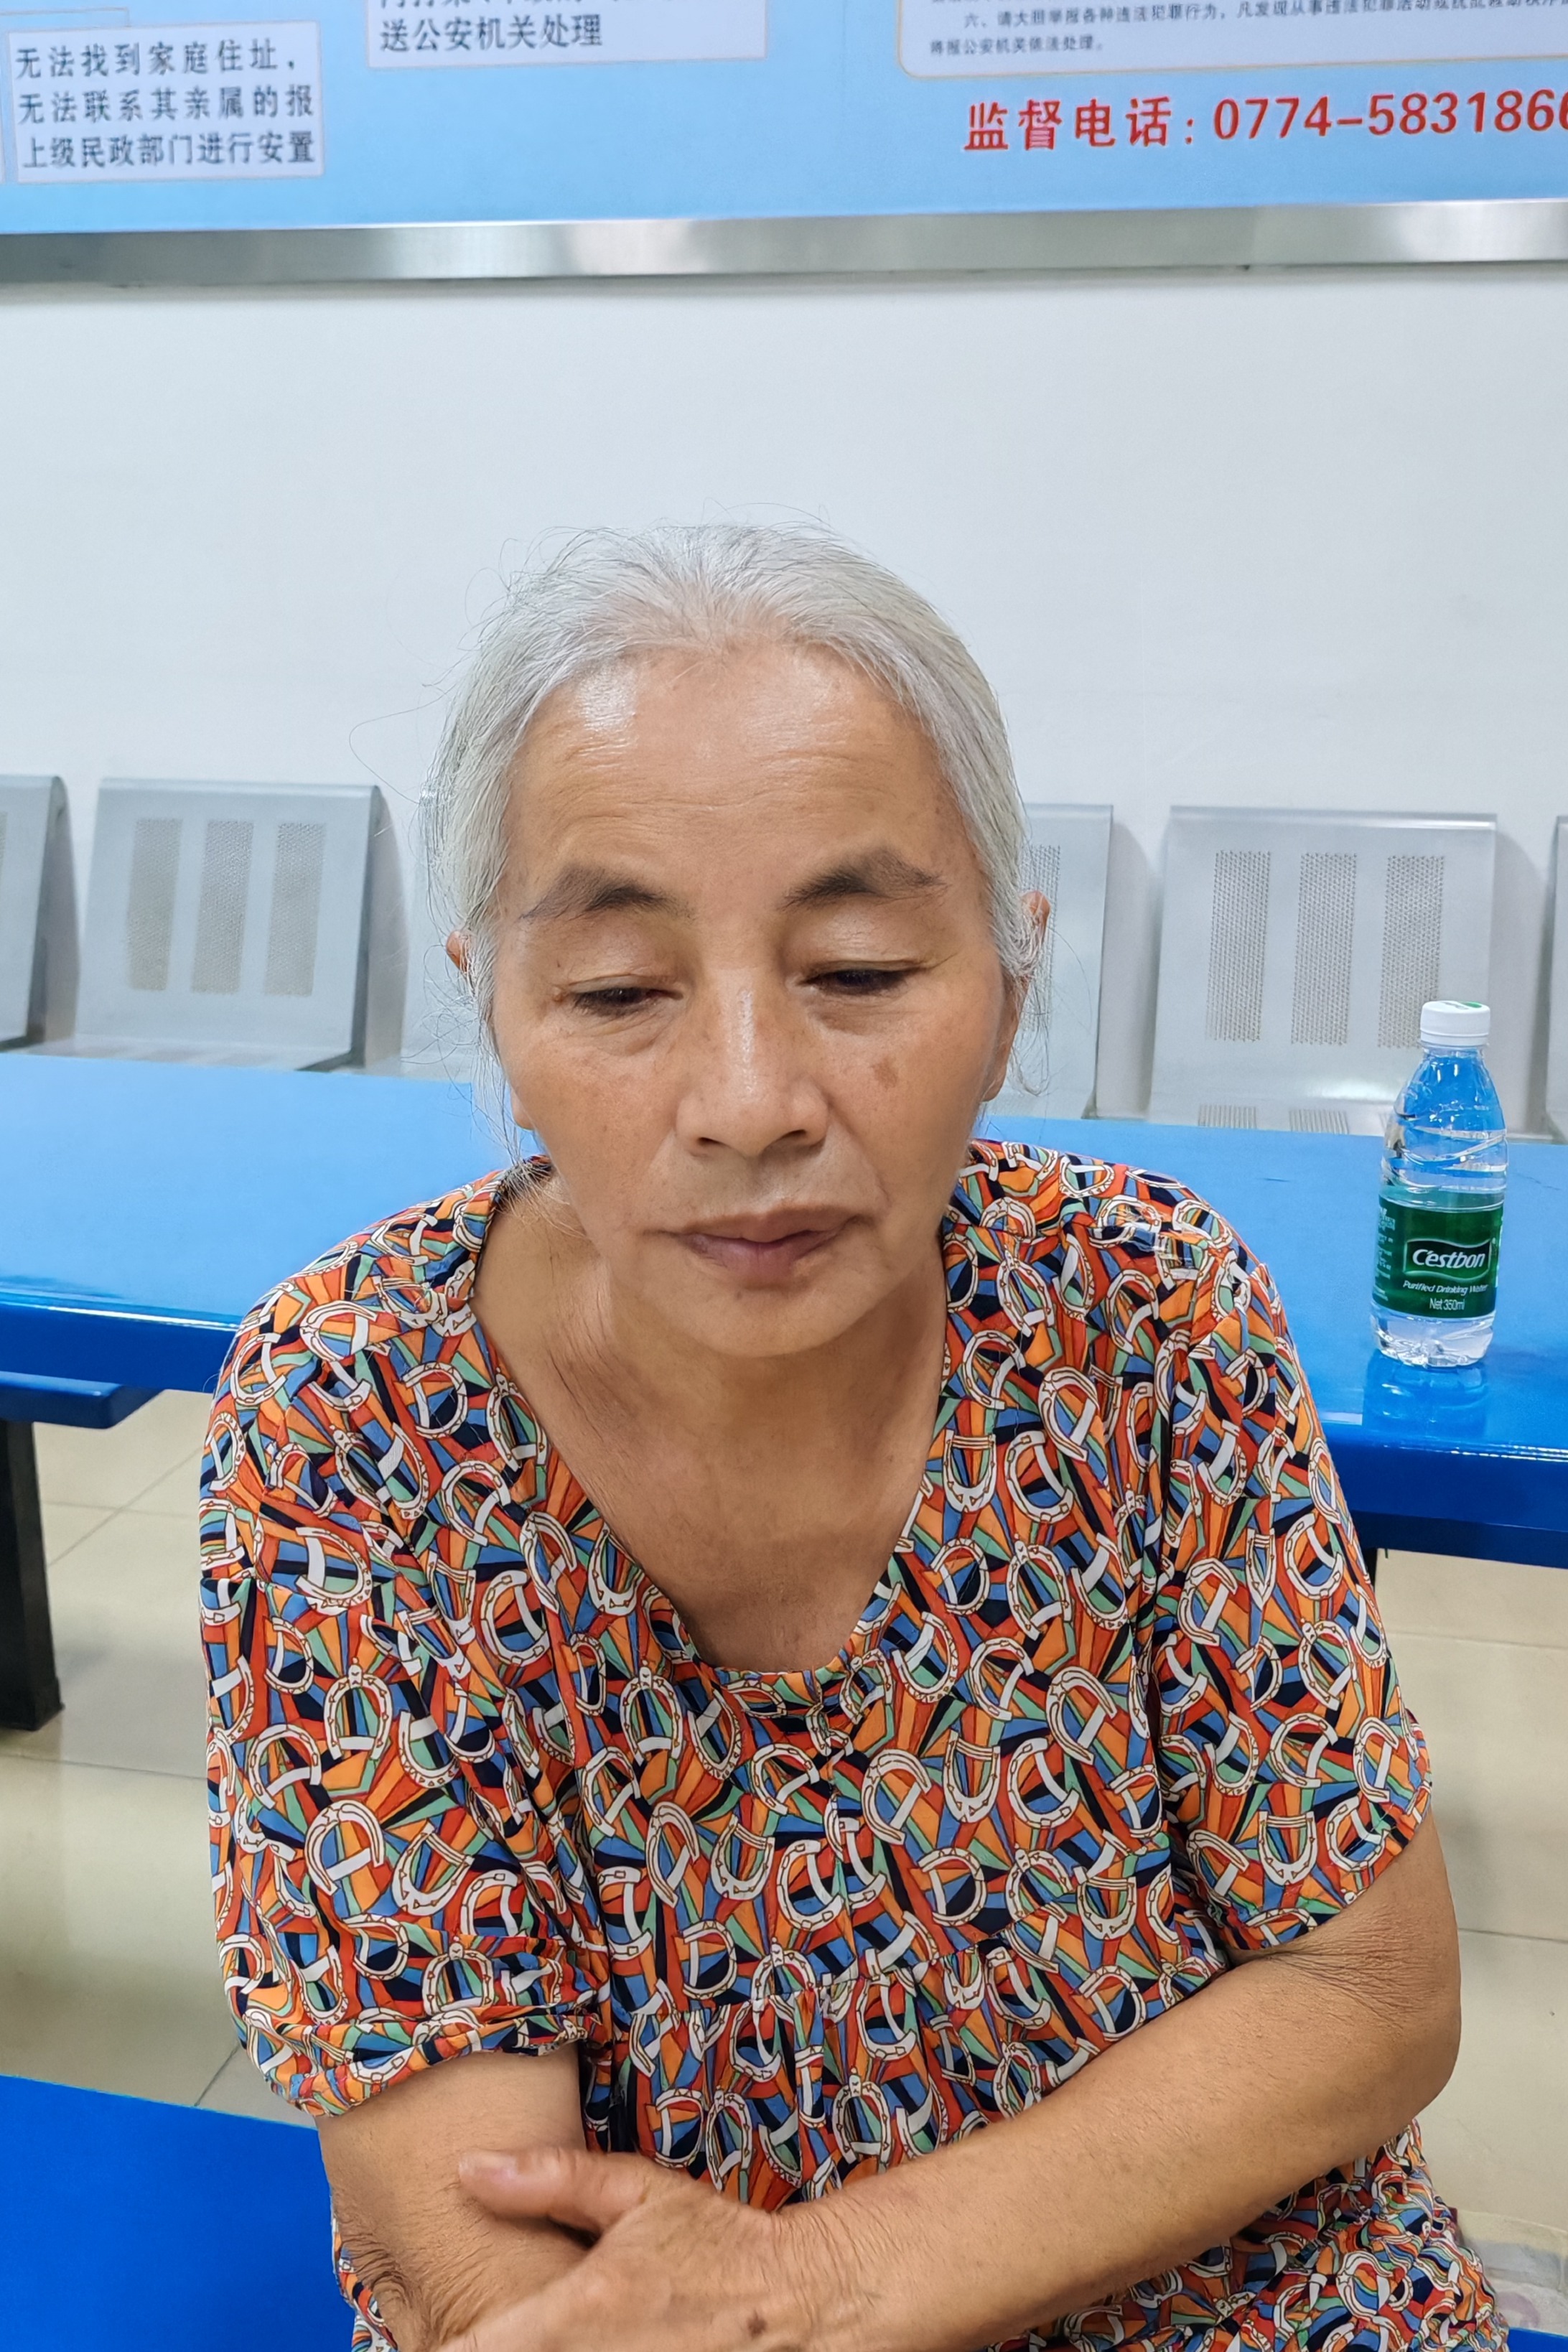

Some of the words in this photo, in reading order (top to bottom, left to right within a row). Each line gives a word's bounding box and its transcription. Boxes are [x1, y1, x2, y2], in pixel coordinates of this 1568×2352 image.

[379, 13, 603, 52] 送公安机关处理
[18, 83, 314, 125] 无法联系其亲属的报
[22, 130, 316, 169] 上级民政部门进行安置
[1402, 1280, 1434, 1292] Purified
[1436, 1284, 1468, 1297] Drinking
[1429, 1298, 1442, 1310] Net
